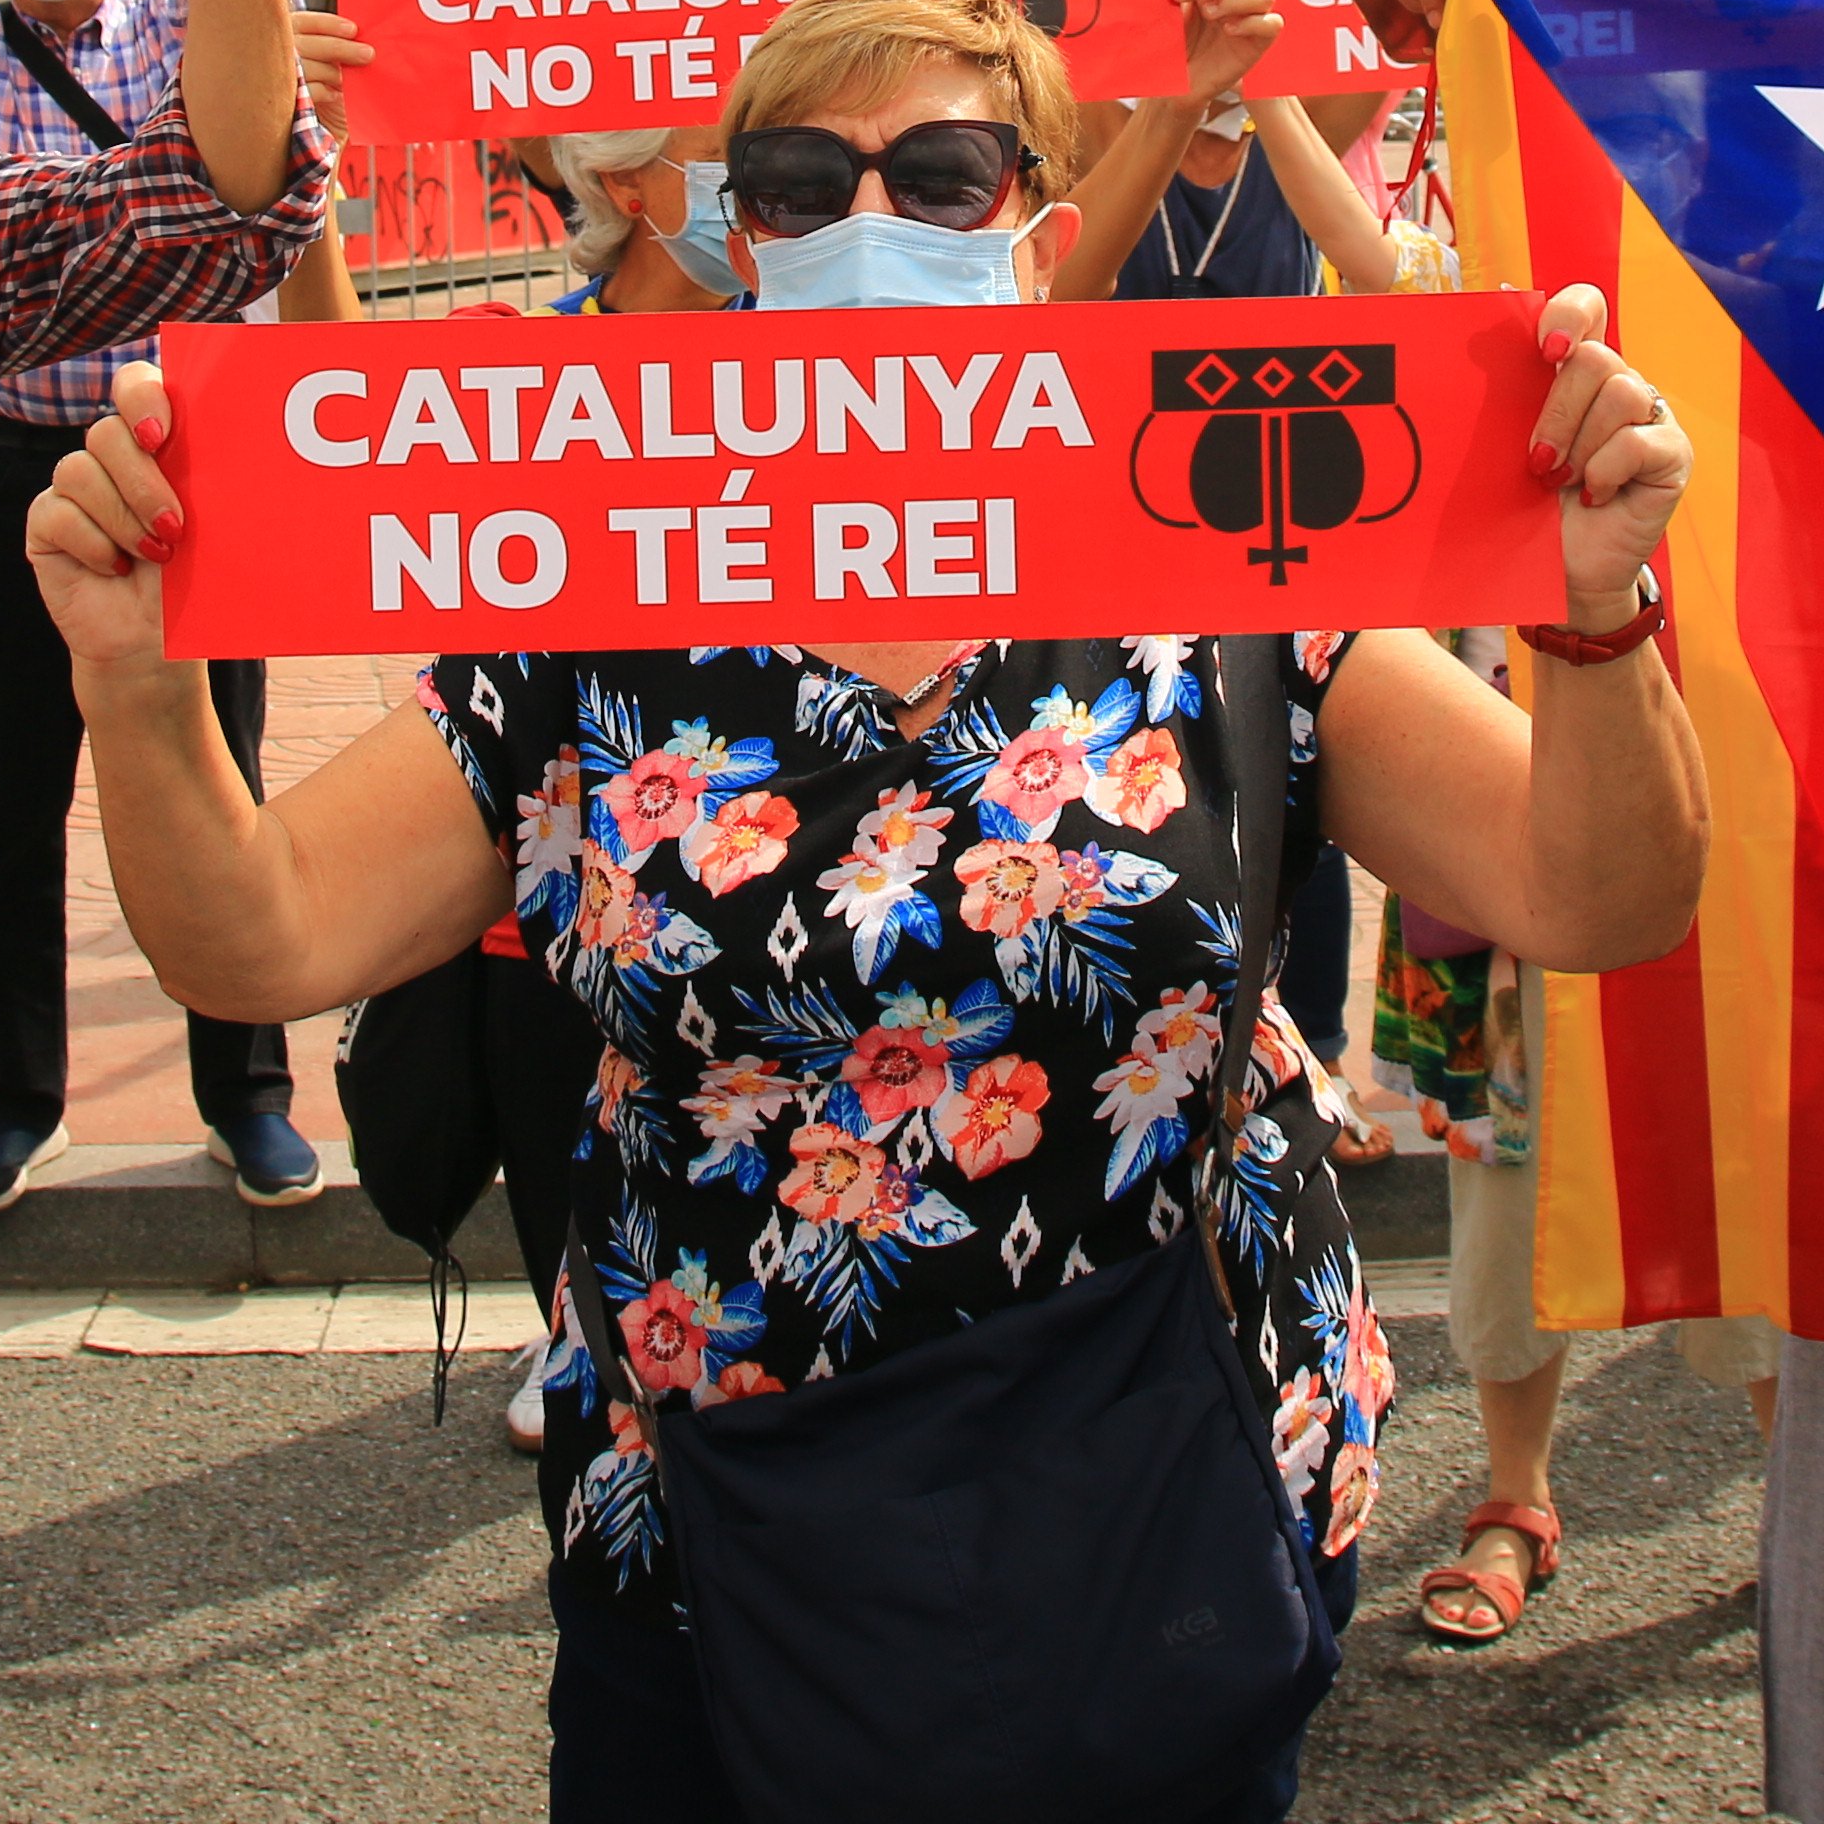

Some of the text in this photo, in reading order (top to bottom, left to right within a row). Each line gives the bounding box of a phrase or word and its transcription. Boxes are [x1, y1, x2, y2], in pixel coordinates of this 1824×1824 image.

[469, 47, 593, 112] NO
[614, 15, 718, 102] TÉ
[281, 350, 1097, 468] CATALUNYA
[367, 467, 1018, 612] NO TÉ REI
